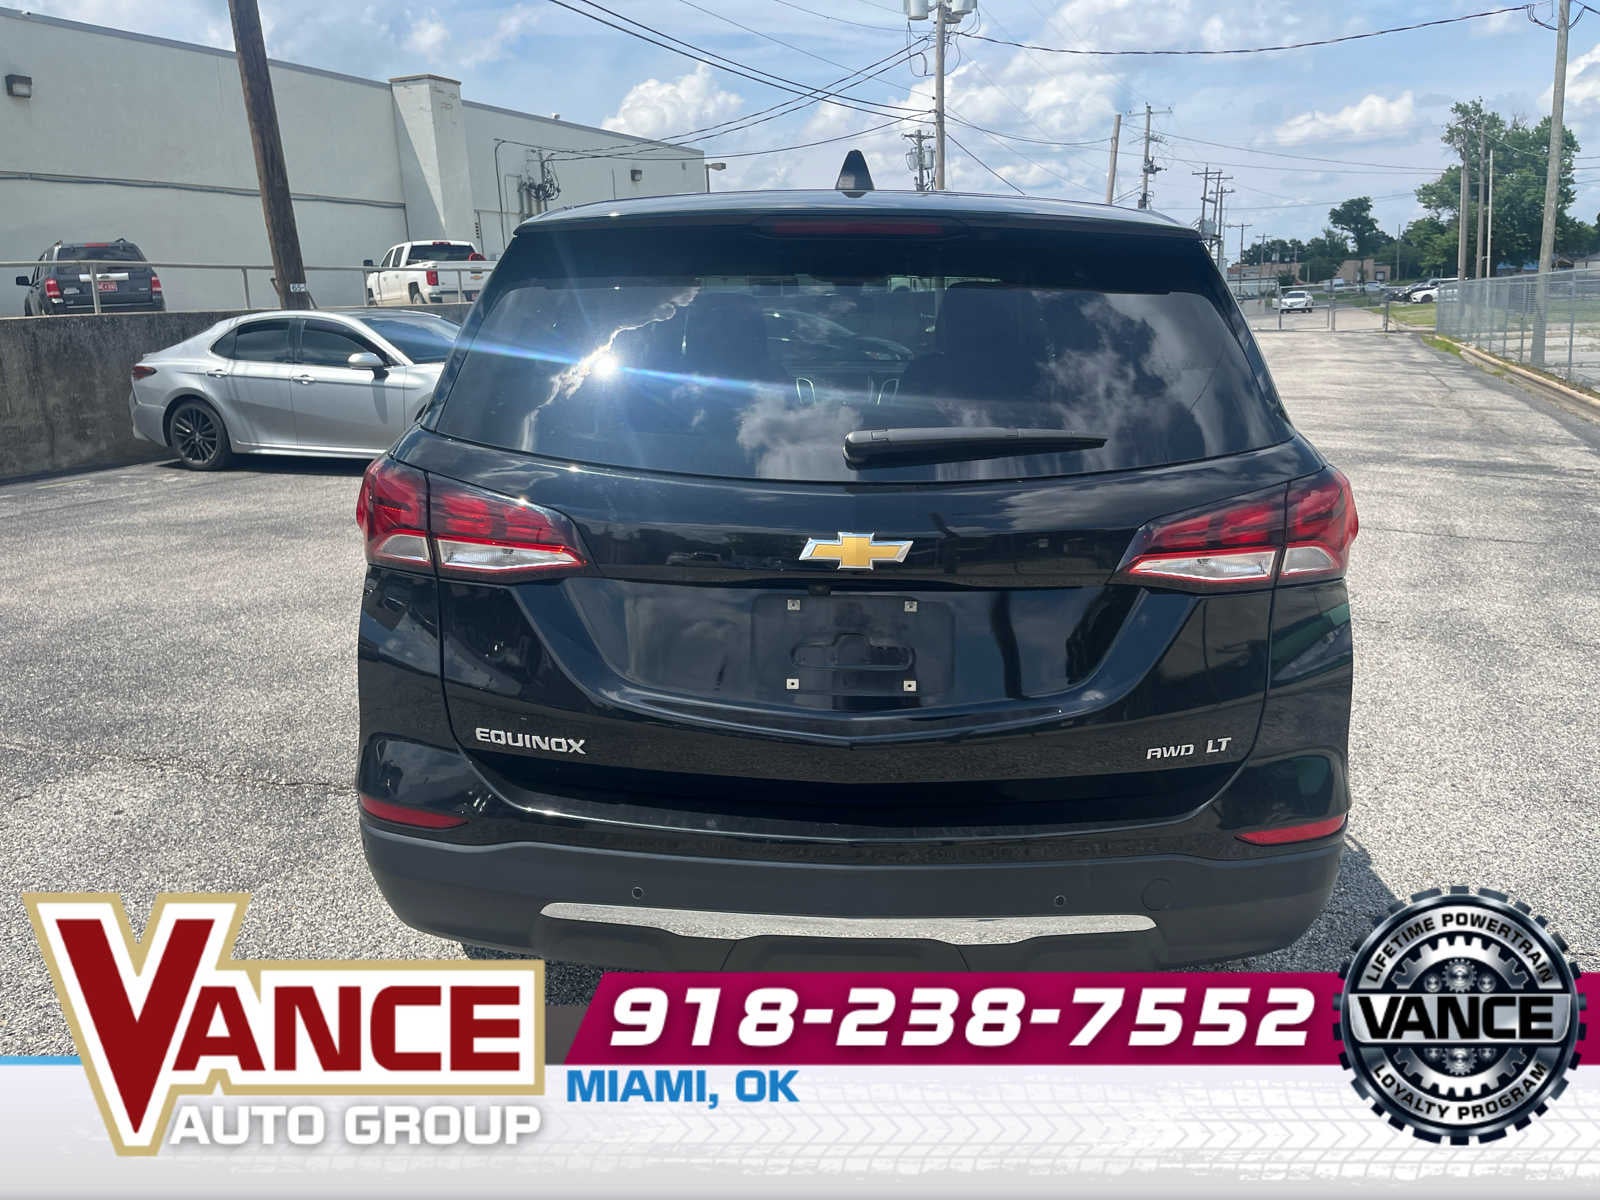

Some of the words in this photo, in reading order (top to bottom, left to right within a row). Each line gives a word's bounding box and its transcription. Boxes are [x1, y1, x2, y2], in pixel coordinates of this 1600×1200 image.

[475, 727, 586, 755] EQUINOX
[1146, 744, 1195, 760] AWD
[1206, 737, 1232, 754] LT
